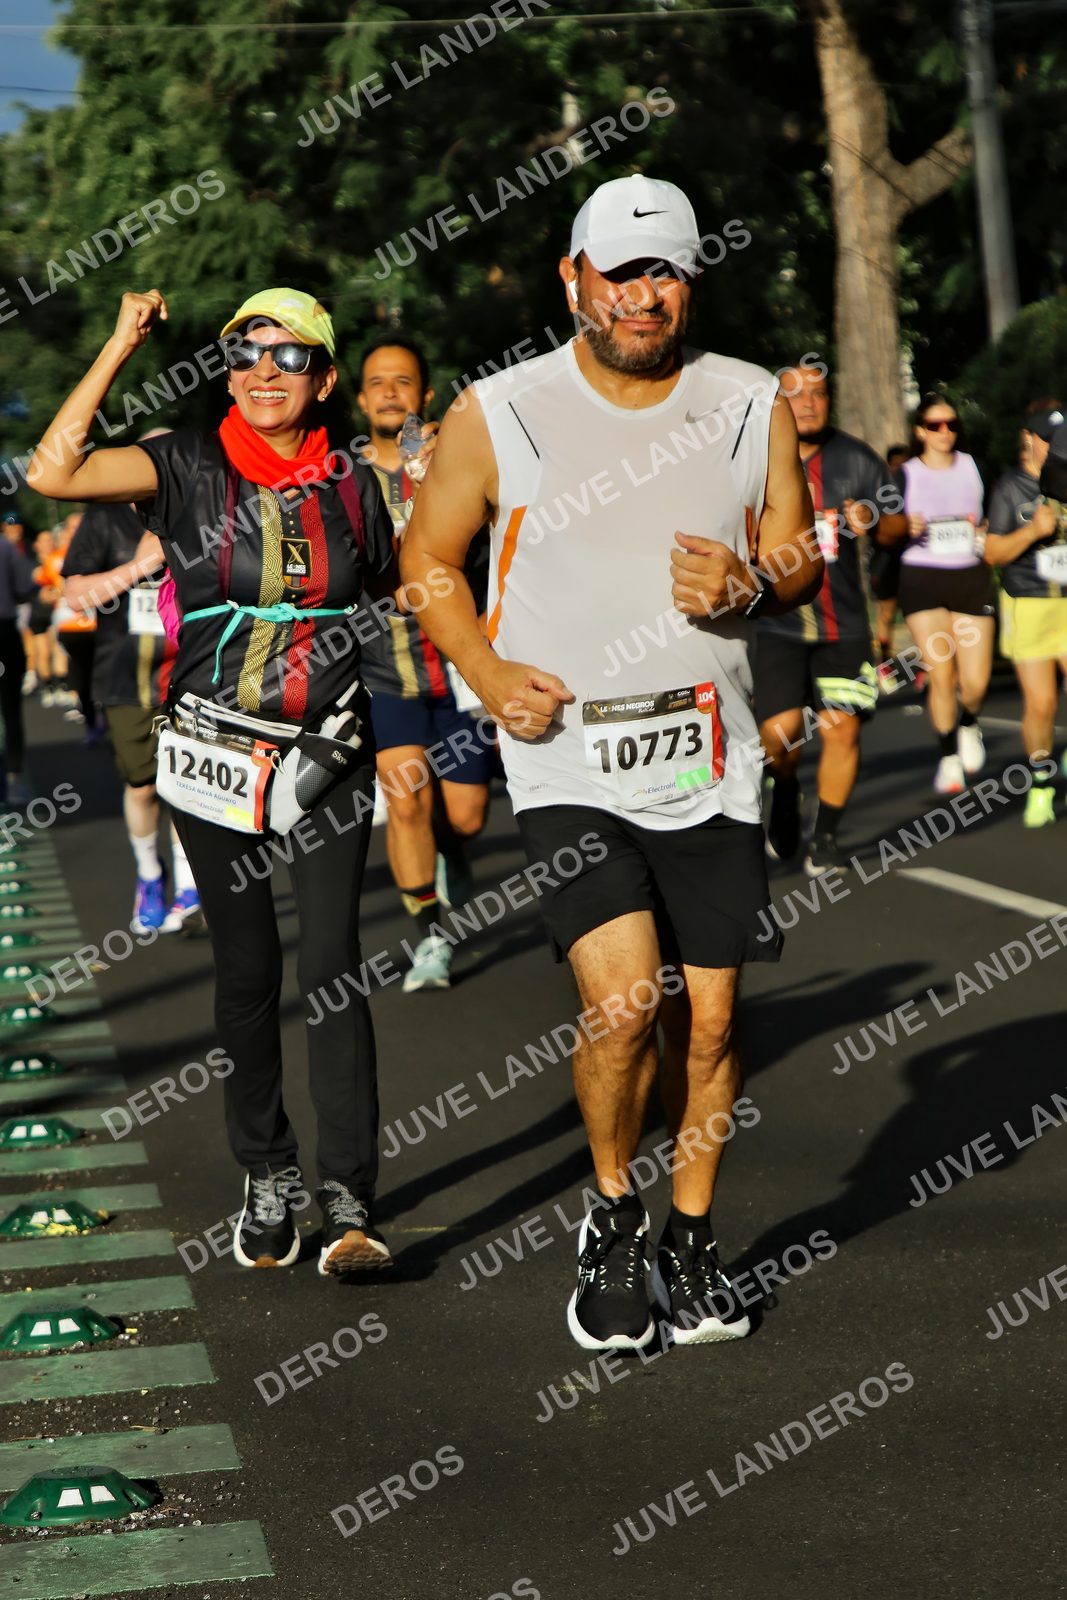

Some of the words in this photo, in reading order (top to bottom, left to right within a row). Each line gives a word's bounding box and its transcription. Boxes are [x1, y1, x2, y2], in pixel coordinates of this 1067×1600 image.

[698, 690, 715, 703] 10K
[592, 722, 704, 774] 10773
[163, 744, 249, 799] 12402
[647, 781, 677, 794] Electrolit
